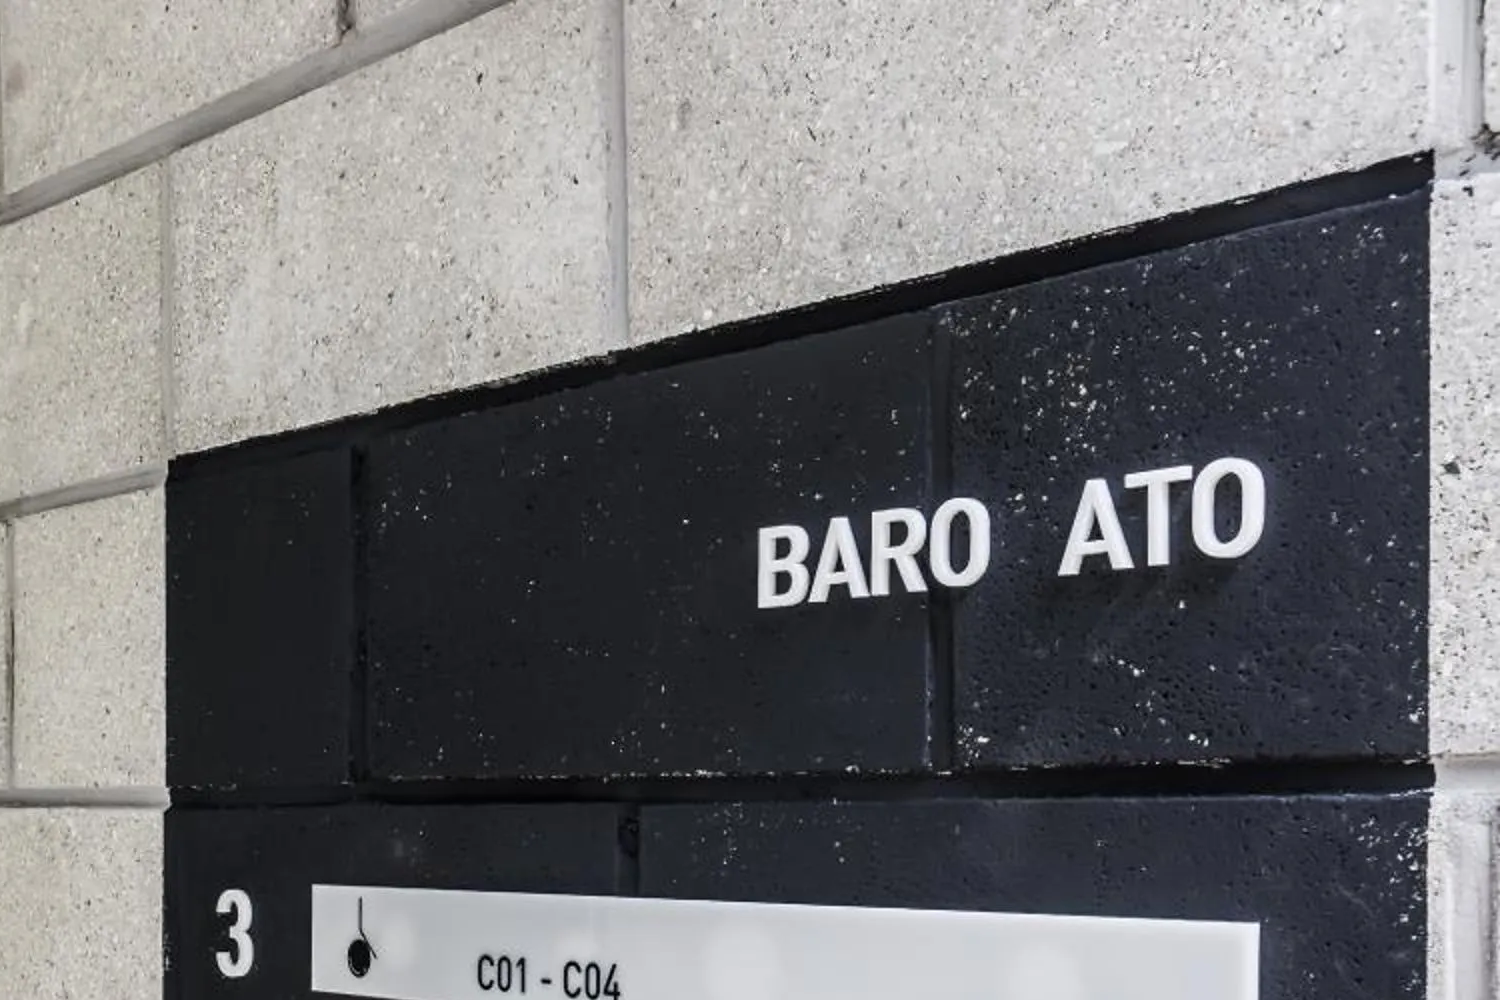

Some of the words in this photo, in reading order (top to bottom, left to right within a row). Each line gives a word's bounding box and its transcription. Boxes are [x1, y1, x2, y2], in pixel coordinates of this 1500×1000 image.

[757, 497, 991, 609] BARO
[1057, 457, 1266, 577] ATO
[215, 889, 254, 978] 3
[476, 953, 528, 994] C01
